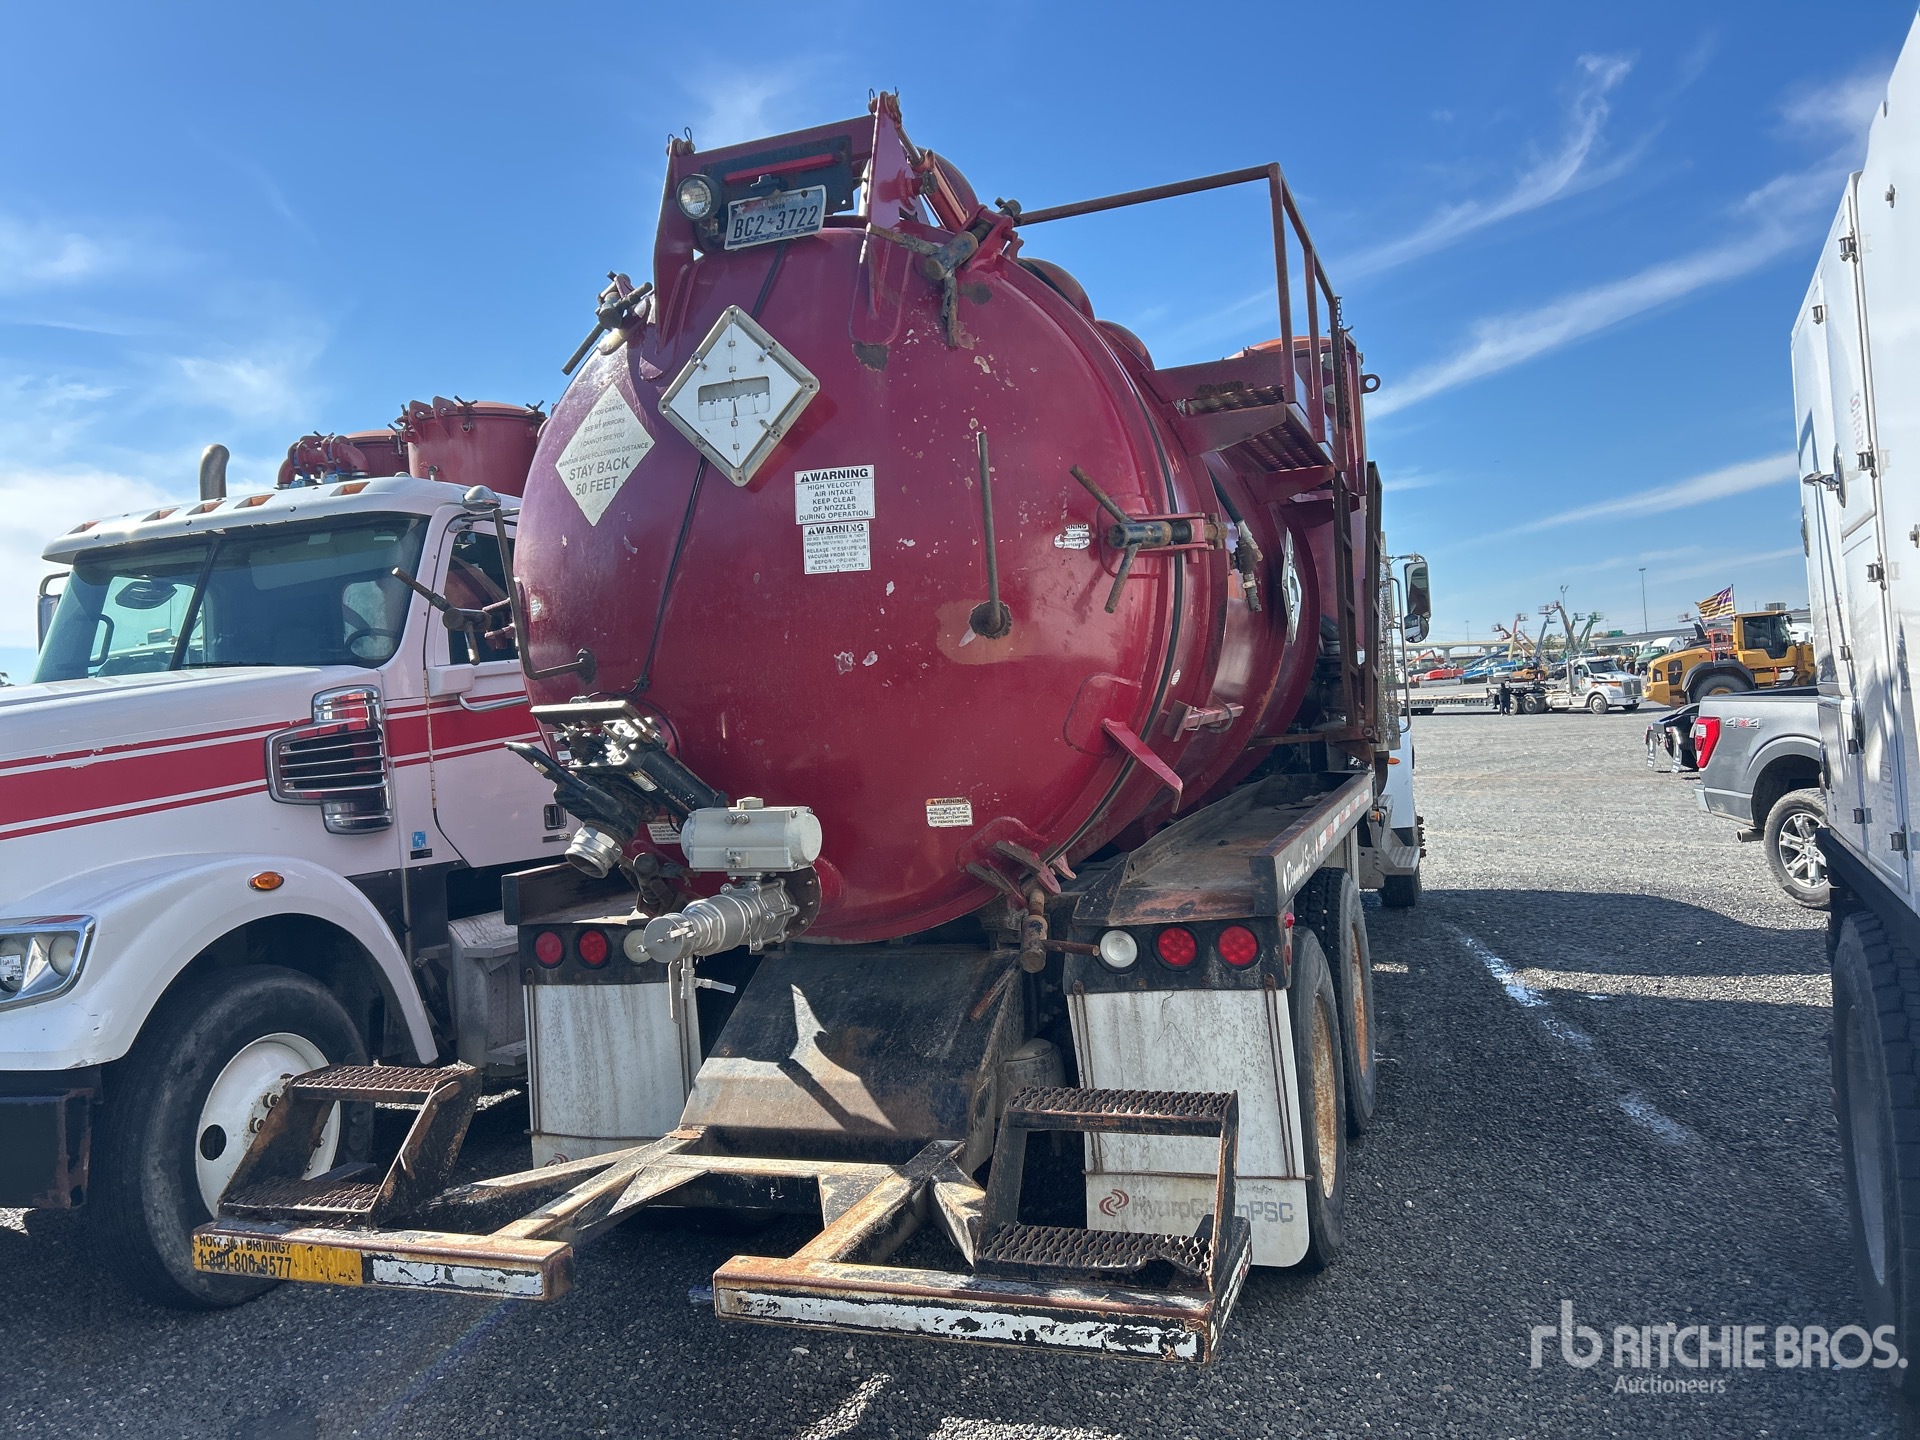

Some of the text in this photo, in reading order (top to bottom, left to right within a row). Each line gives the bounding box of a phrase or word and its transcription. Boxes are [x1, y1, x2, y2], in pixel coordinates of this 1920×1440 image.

[621, 441, 649, 453] DISTANCE
[569, 456, 630, 481] STAY BACK
[810, 468, 869, 481] WARNING
[575, 476, 619, 496] 50 FEET
[807, 481, 861, 491] HIGH VELOCITY
[828, 488, 854, 496] INTAKE
[812, 497, 831, 505] KEEP
[824, 503, 857, 511] NOZZLES
[799, 513, 826, 521] DURING
[816, 523, 865, 534] WARNING
[246, 1240, 291, 1255] DRIVING?
